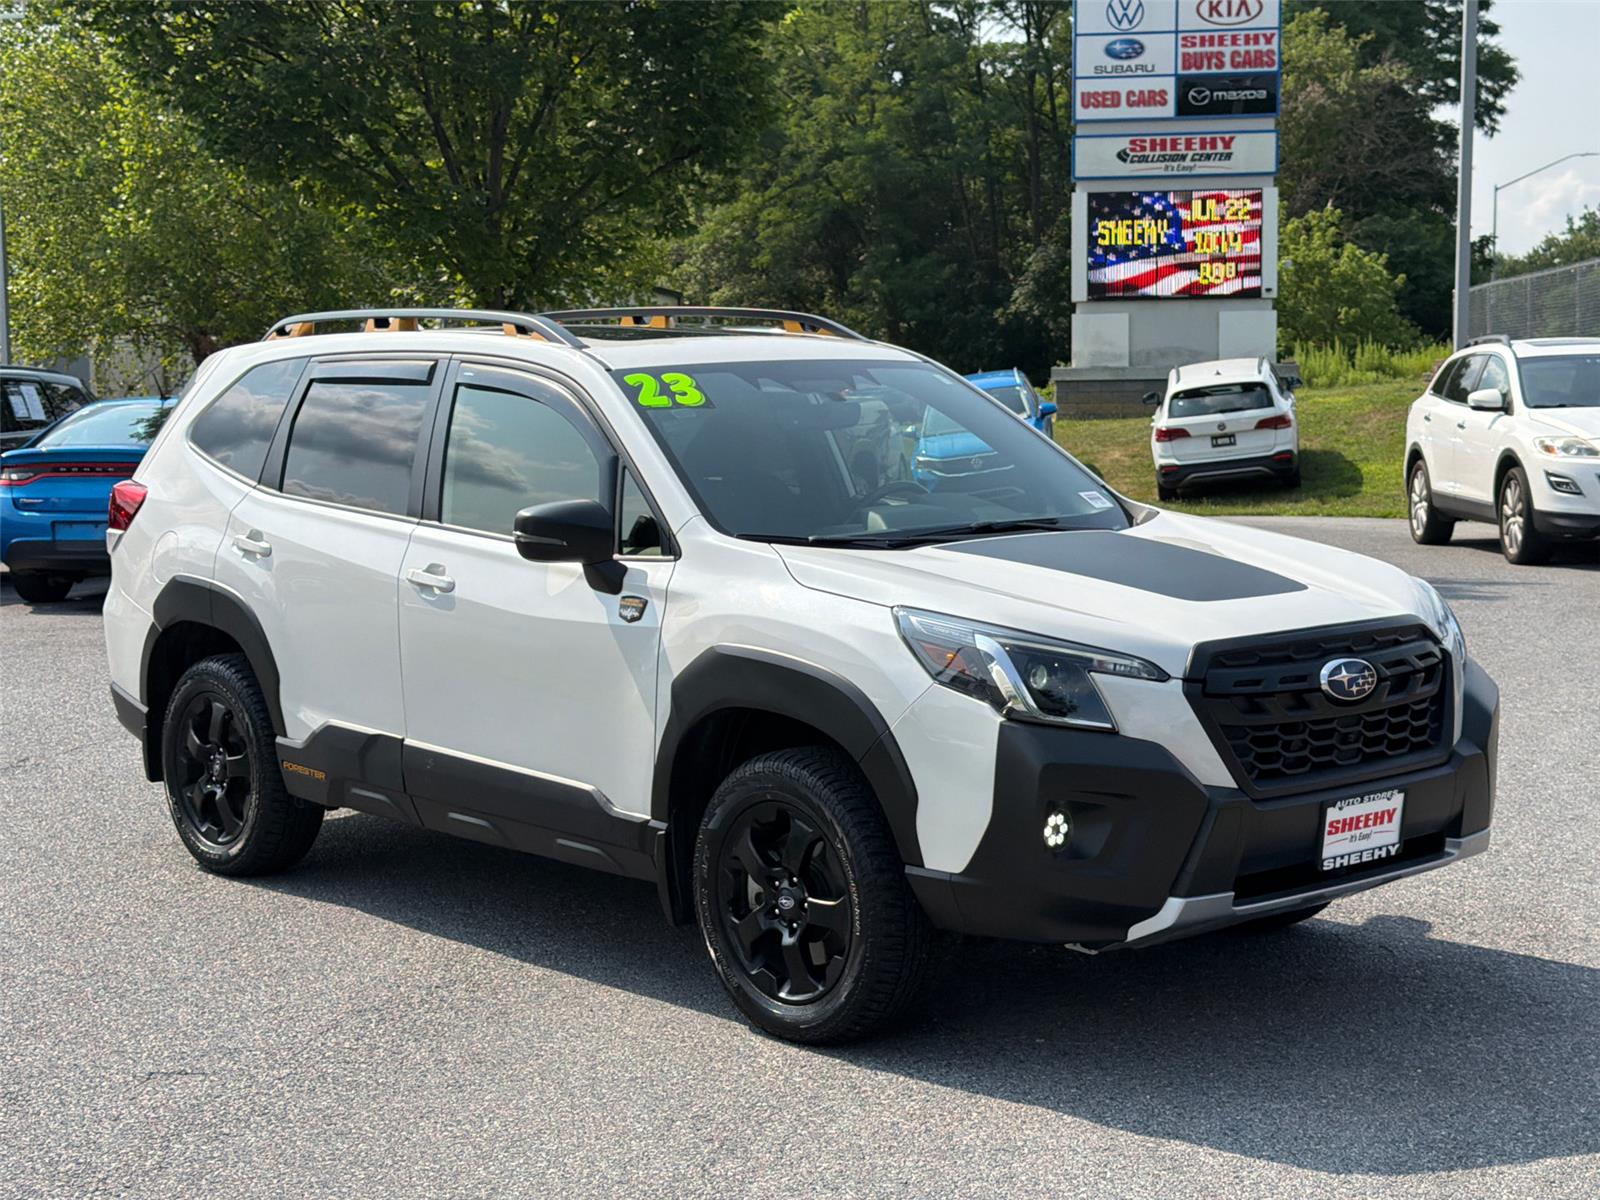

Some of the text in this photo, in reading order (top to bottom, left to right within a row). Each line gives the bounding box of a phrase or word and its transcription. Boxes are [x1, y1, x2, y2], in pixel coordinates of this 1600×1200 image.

[1181, 32, 1277, 48] SHEEHY
[1181, 48, 1276, 71] BUYS CARS
[1093, 63, 1155, 75] SUBARU
[1080, 88, 1168, 109] USED CARS
[1128, 135, 1236, 153] SHEEHY
[1129, 152, 1234, 164] COLLISION CENTER
[1163, 163, 1197, 173] It's Easy!
[1098, 218, 1168, 246] SHEEHY
[623, 372, 706, 407] 23
[283, 761, 326, 780] FORESTER
[1336, 789, 1399, 807] AUTO STORES
[1327, 807, 1398, 836] SHEEHY
[1349, 830, 1373, 843] It's Easy!
[1322, 843, 1400, 871] SHEEHY
